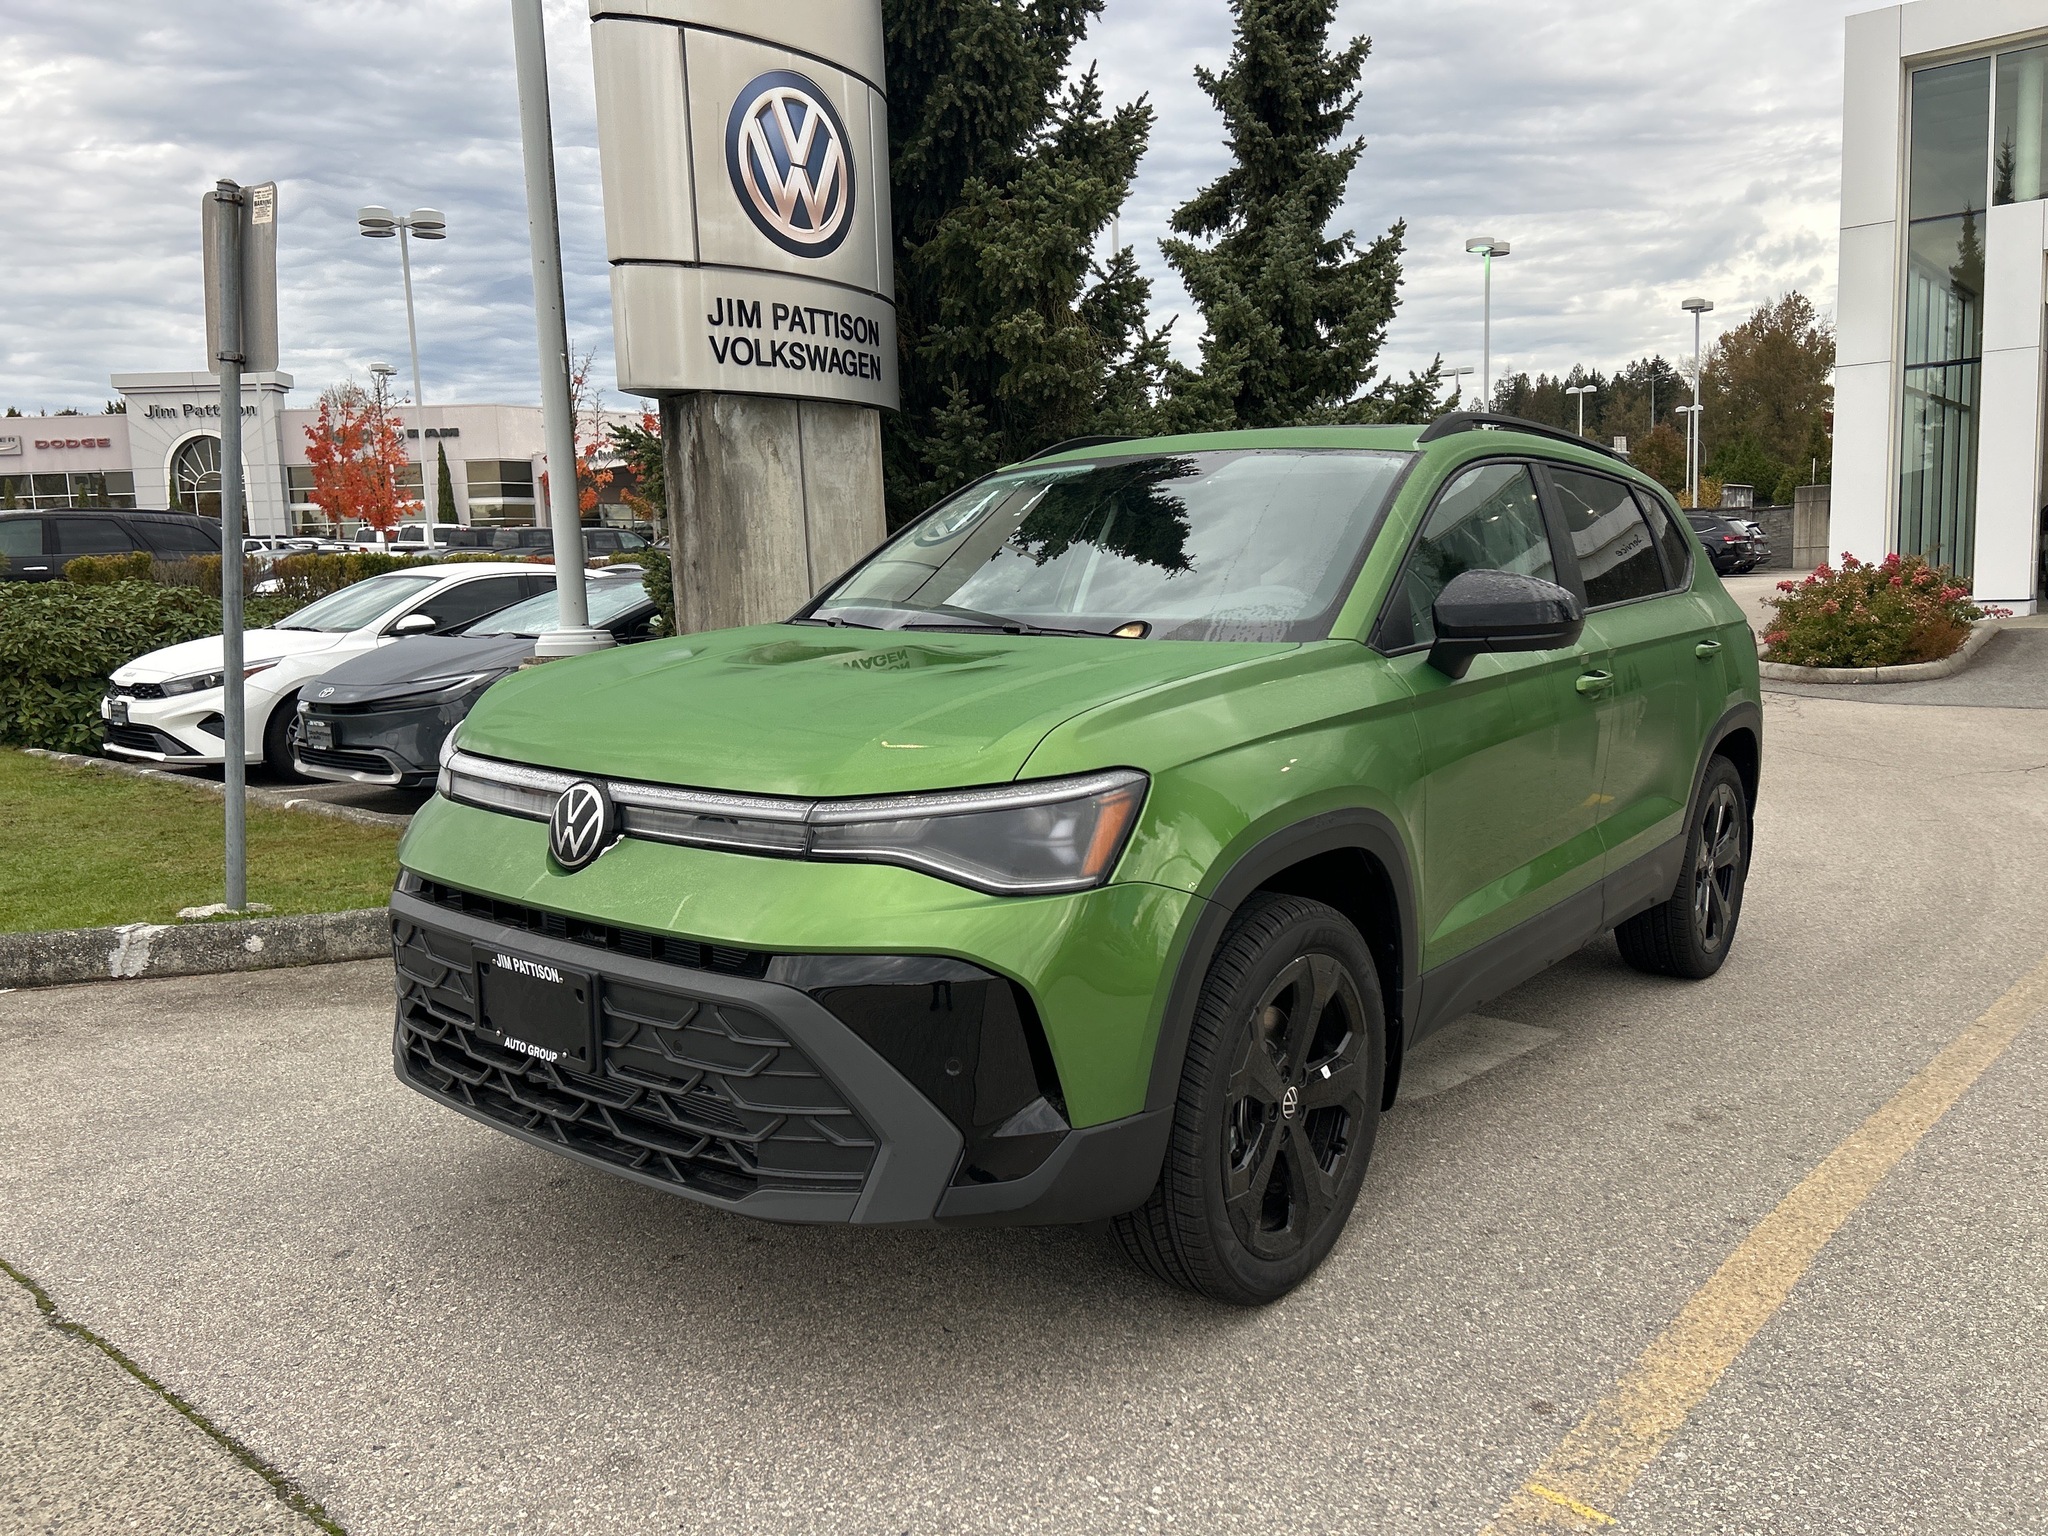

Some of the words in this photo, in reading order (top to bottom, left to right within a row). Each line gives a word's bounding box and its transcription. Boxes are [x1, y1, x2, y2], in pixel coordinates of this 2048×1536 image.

[707, 297, 762, 329] JIM
[772, 302, 880, 347] PATTISON
[708, 335, 882, 381] VOLKSWAGEN
[144, 405, 177, 418] Jim
[34, 438, 110, 449] DODGE
[496, 953, 513, 970] JIM
[512, 957, 560, 983] PATTISON
[504, 1036, 527, 1053] AUTO
[527, 1045, 558, 1063] GROUP
